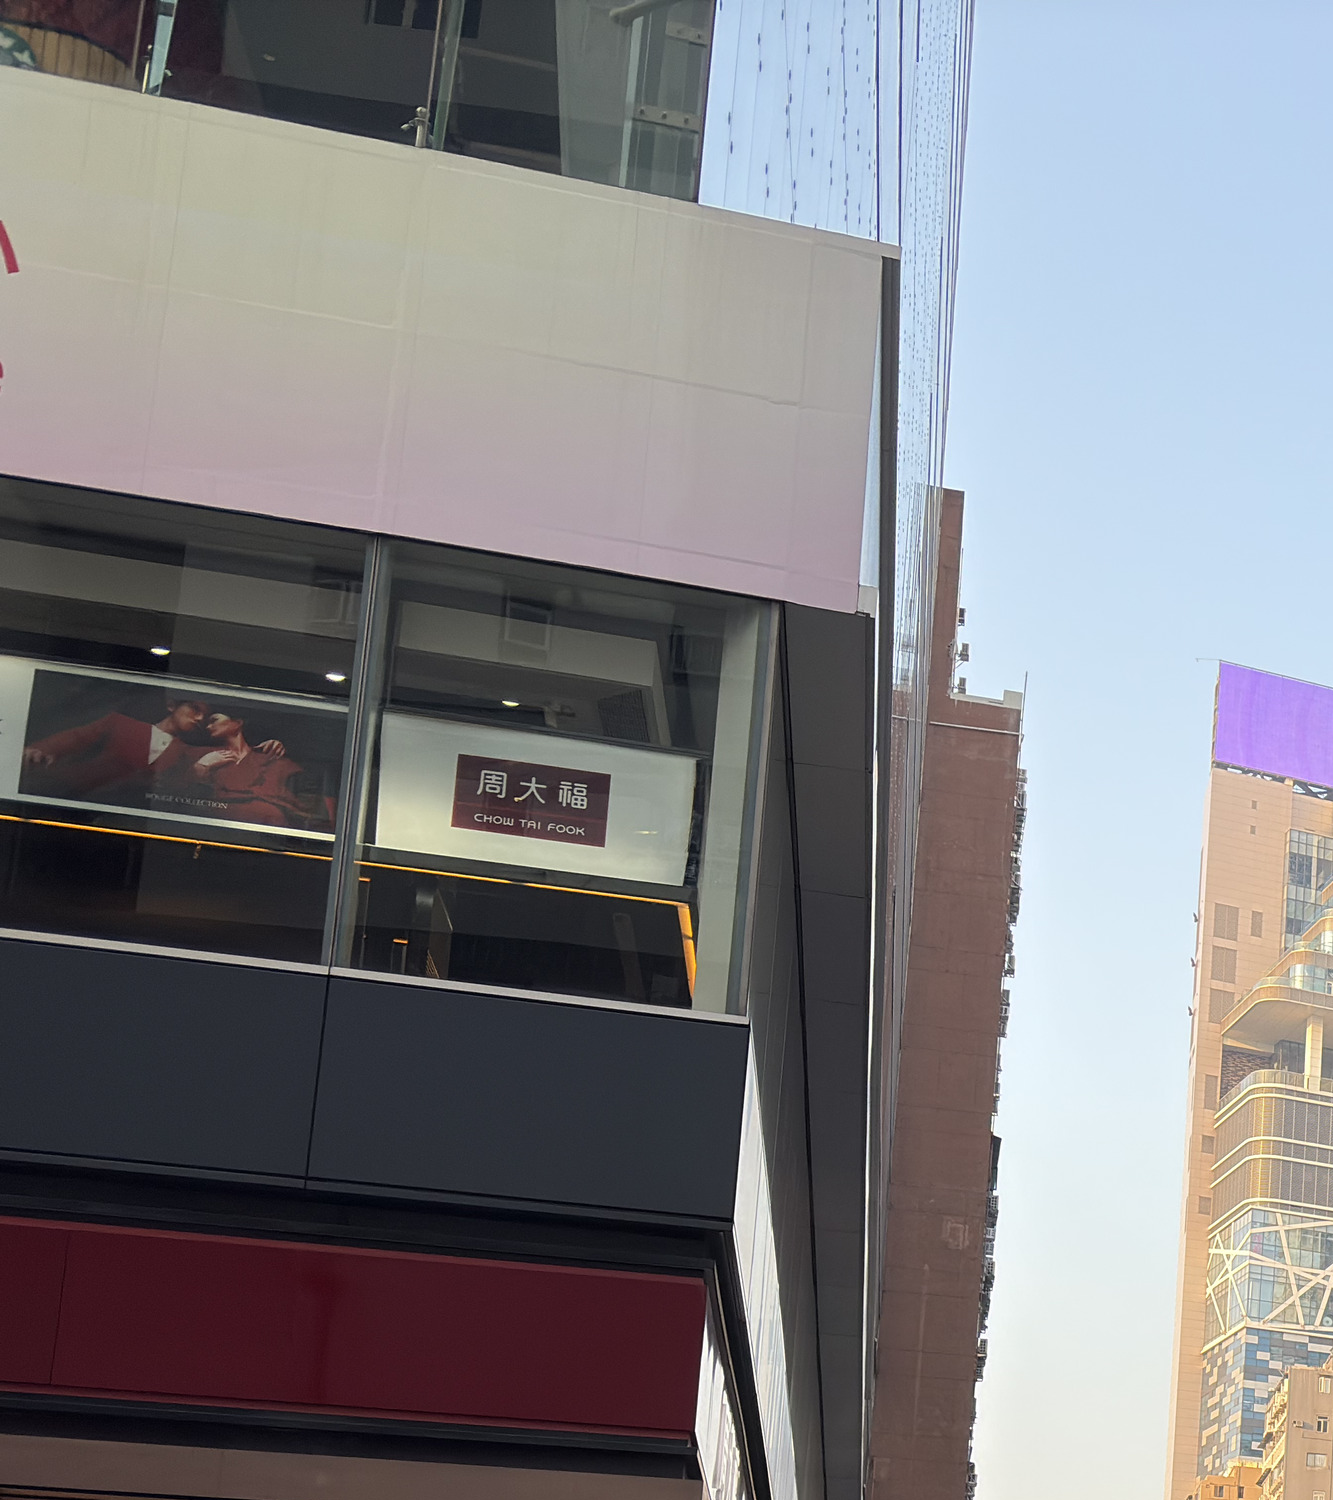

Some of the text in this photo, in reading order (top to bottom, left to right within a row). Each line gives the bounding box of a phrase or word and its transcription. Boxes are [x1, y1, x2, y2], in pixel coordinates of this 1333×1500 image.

[476, 769, 588, 810] 周大福
[474, 813, 585, 836] CHOW TAI FOOK
